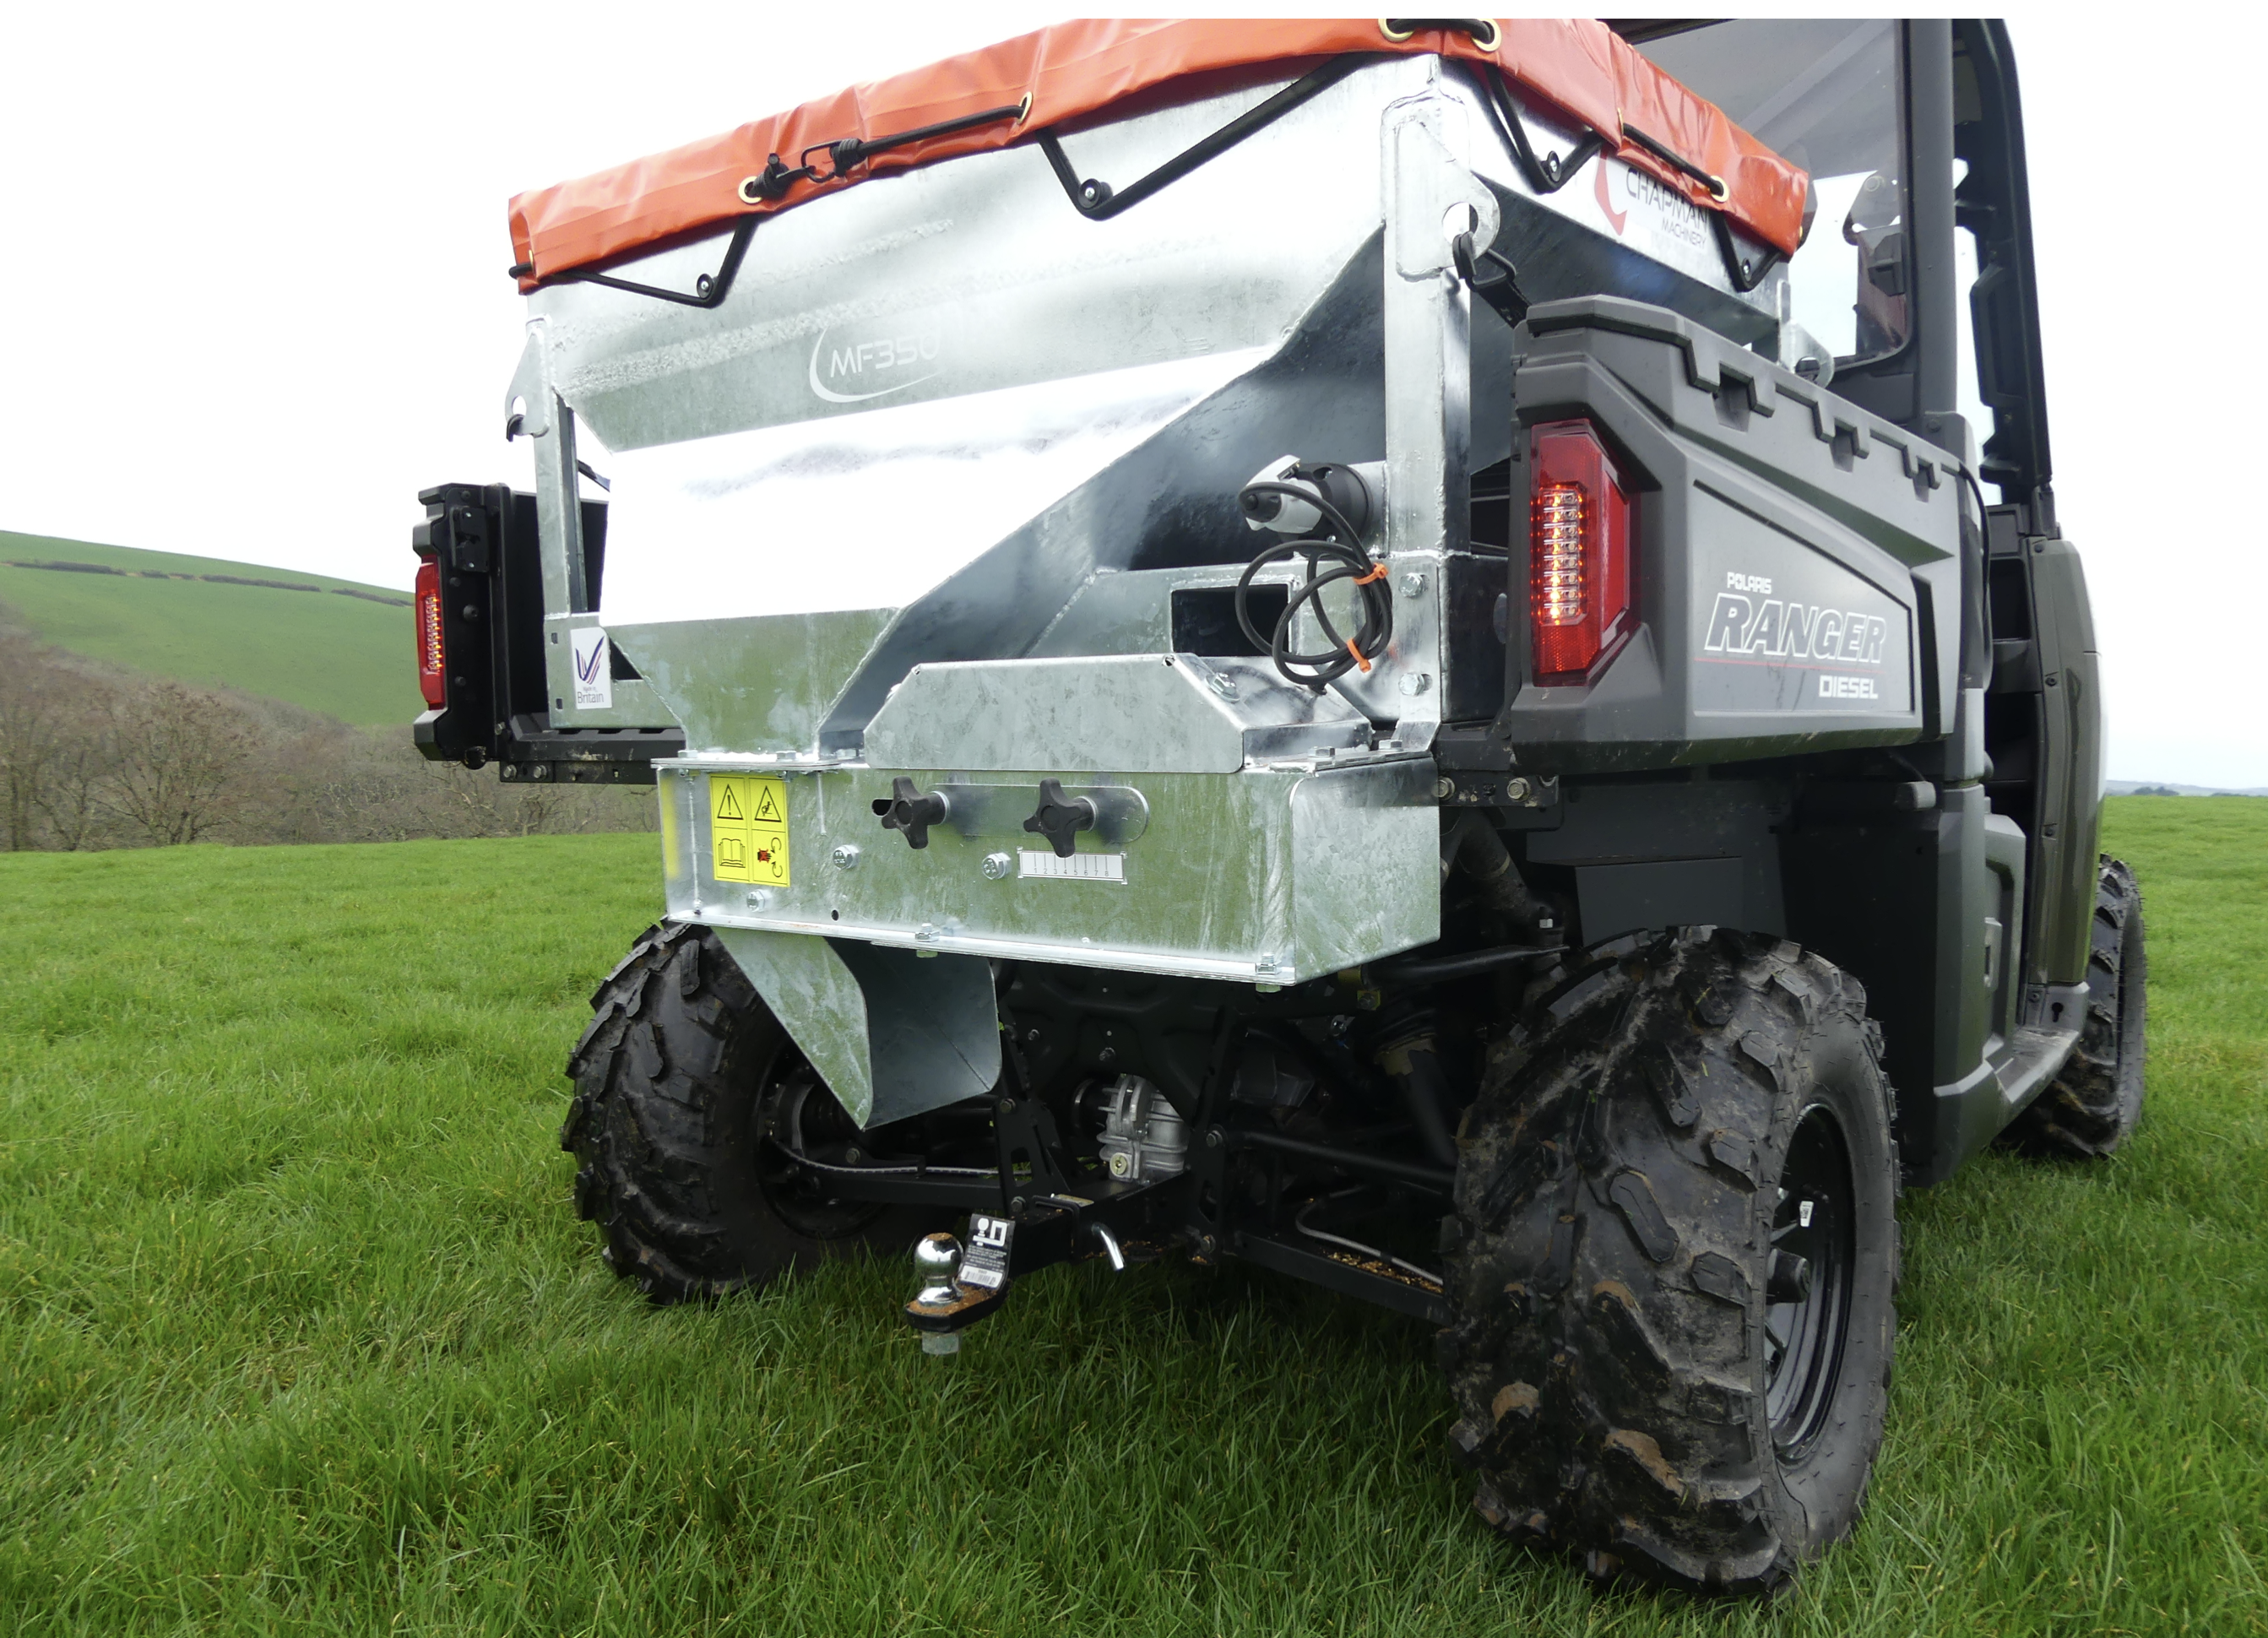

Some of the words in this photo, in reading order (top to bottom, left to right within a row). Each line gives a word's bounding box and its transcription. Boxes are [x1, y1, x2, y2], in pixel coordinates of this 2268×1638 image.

[1626, 167, 1707, 233] CHAPMAN
[1662, 217, 1706, 249] MACHINERY
[830, 335, 940, 377] MF350
[1727, 572, 1772, 594] POLARIS
[1704, 592, 1886, 664] RANGER
[577, 692, 604, 703] Britain
[1819, 675, 1878, 699] DIESEL
